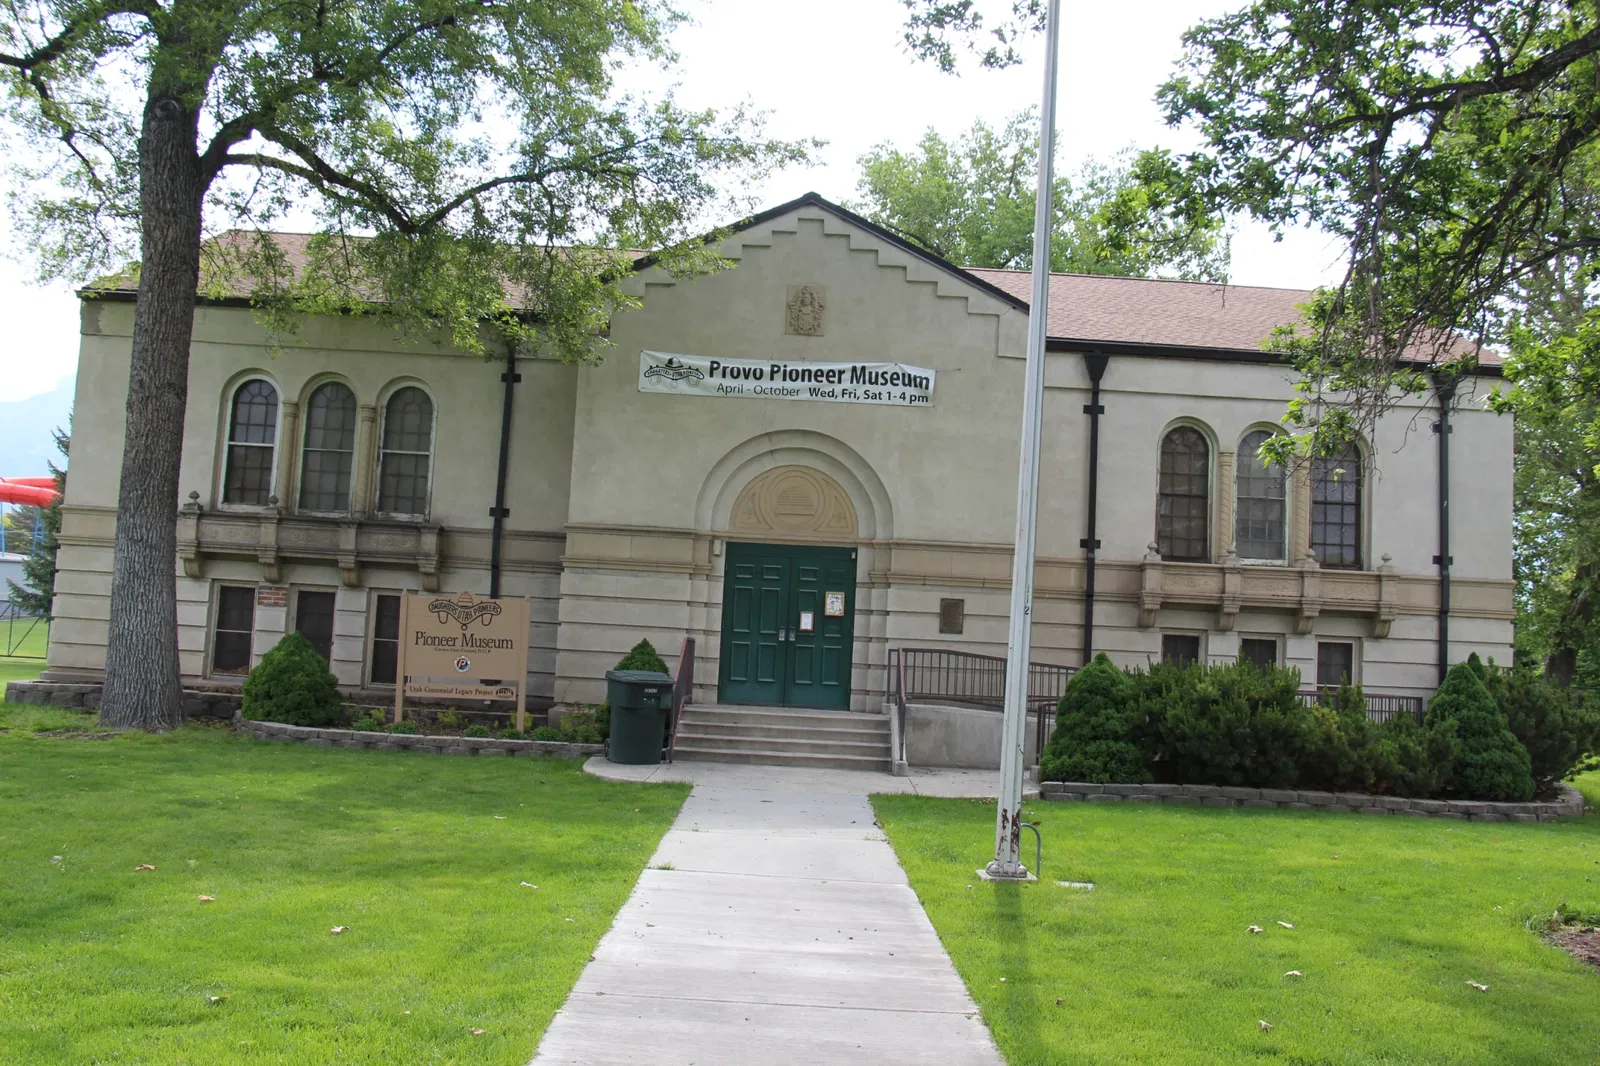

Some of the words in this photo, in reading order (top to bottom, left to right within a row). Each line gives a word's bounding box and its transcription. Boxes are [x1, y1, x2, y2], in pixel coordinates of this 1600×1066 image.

[709, 360, 764, 381] Provo
[769, 364, 845, 384] Pioneer
[850, 365, 930, 390] Museum
[716, 383, 743, 395] April
[753, 385, 800, 397] October
[808, 387, 838, 400] Wed,
[841, 389, 860, 401] Fri,
[863, 390, 883, 400] Sat
[909, 394, 929, 404] pm
[431, 602, 459, 616] DAUGHTERS
[457, 610, 473, 622] UTAH
[473, 604, 500, 616] PIONEERS
[414, 631, 459, 647] Pioneer
[460, 633, 514, 649] Museum
[424, 686, 454, 694] Centennial
[455, 688, 472, 696] Legacy
[474, 688, 493, 697] Project
